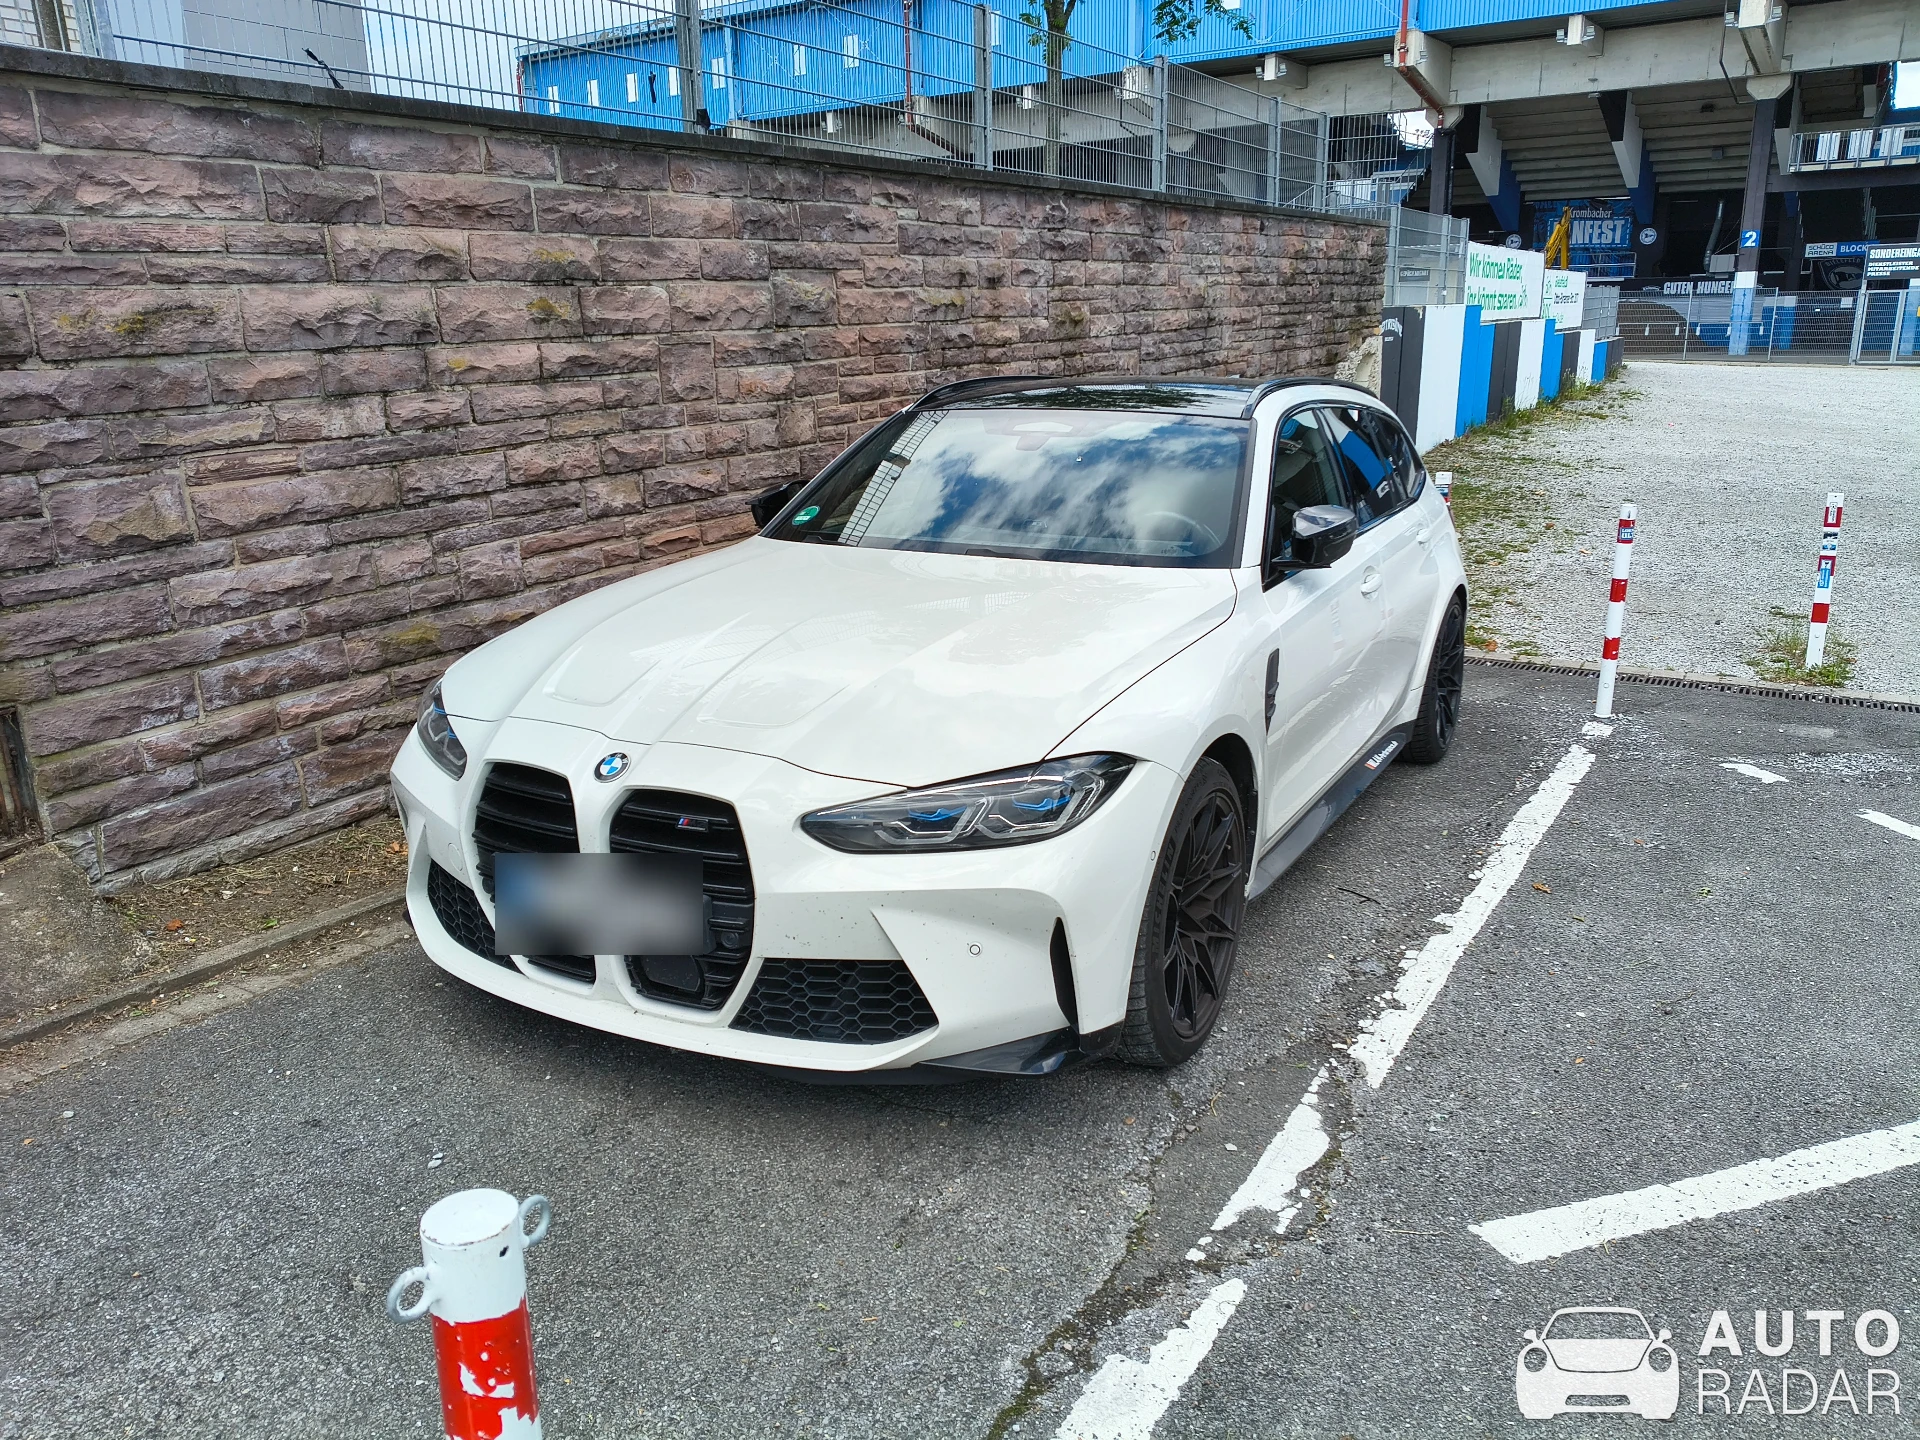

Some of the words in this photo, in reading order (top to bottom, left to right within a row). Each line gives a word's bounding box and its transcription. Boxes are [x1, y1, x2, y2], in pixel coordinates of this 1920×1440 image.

[1553, 220, 1625, 245] NFEST
[1743, 230, 1757, 247] 2
[1808, 243, 1834, 251] SCHÜCO
[1840, 244, 1867, 253] BLOCK
[1469, 252, 1482, 277] Wir
[1663, 281, 1694, 295] GUTEN
